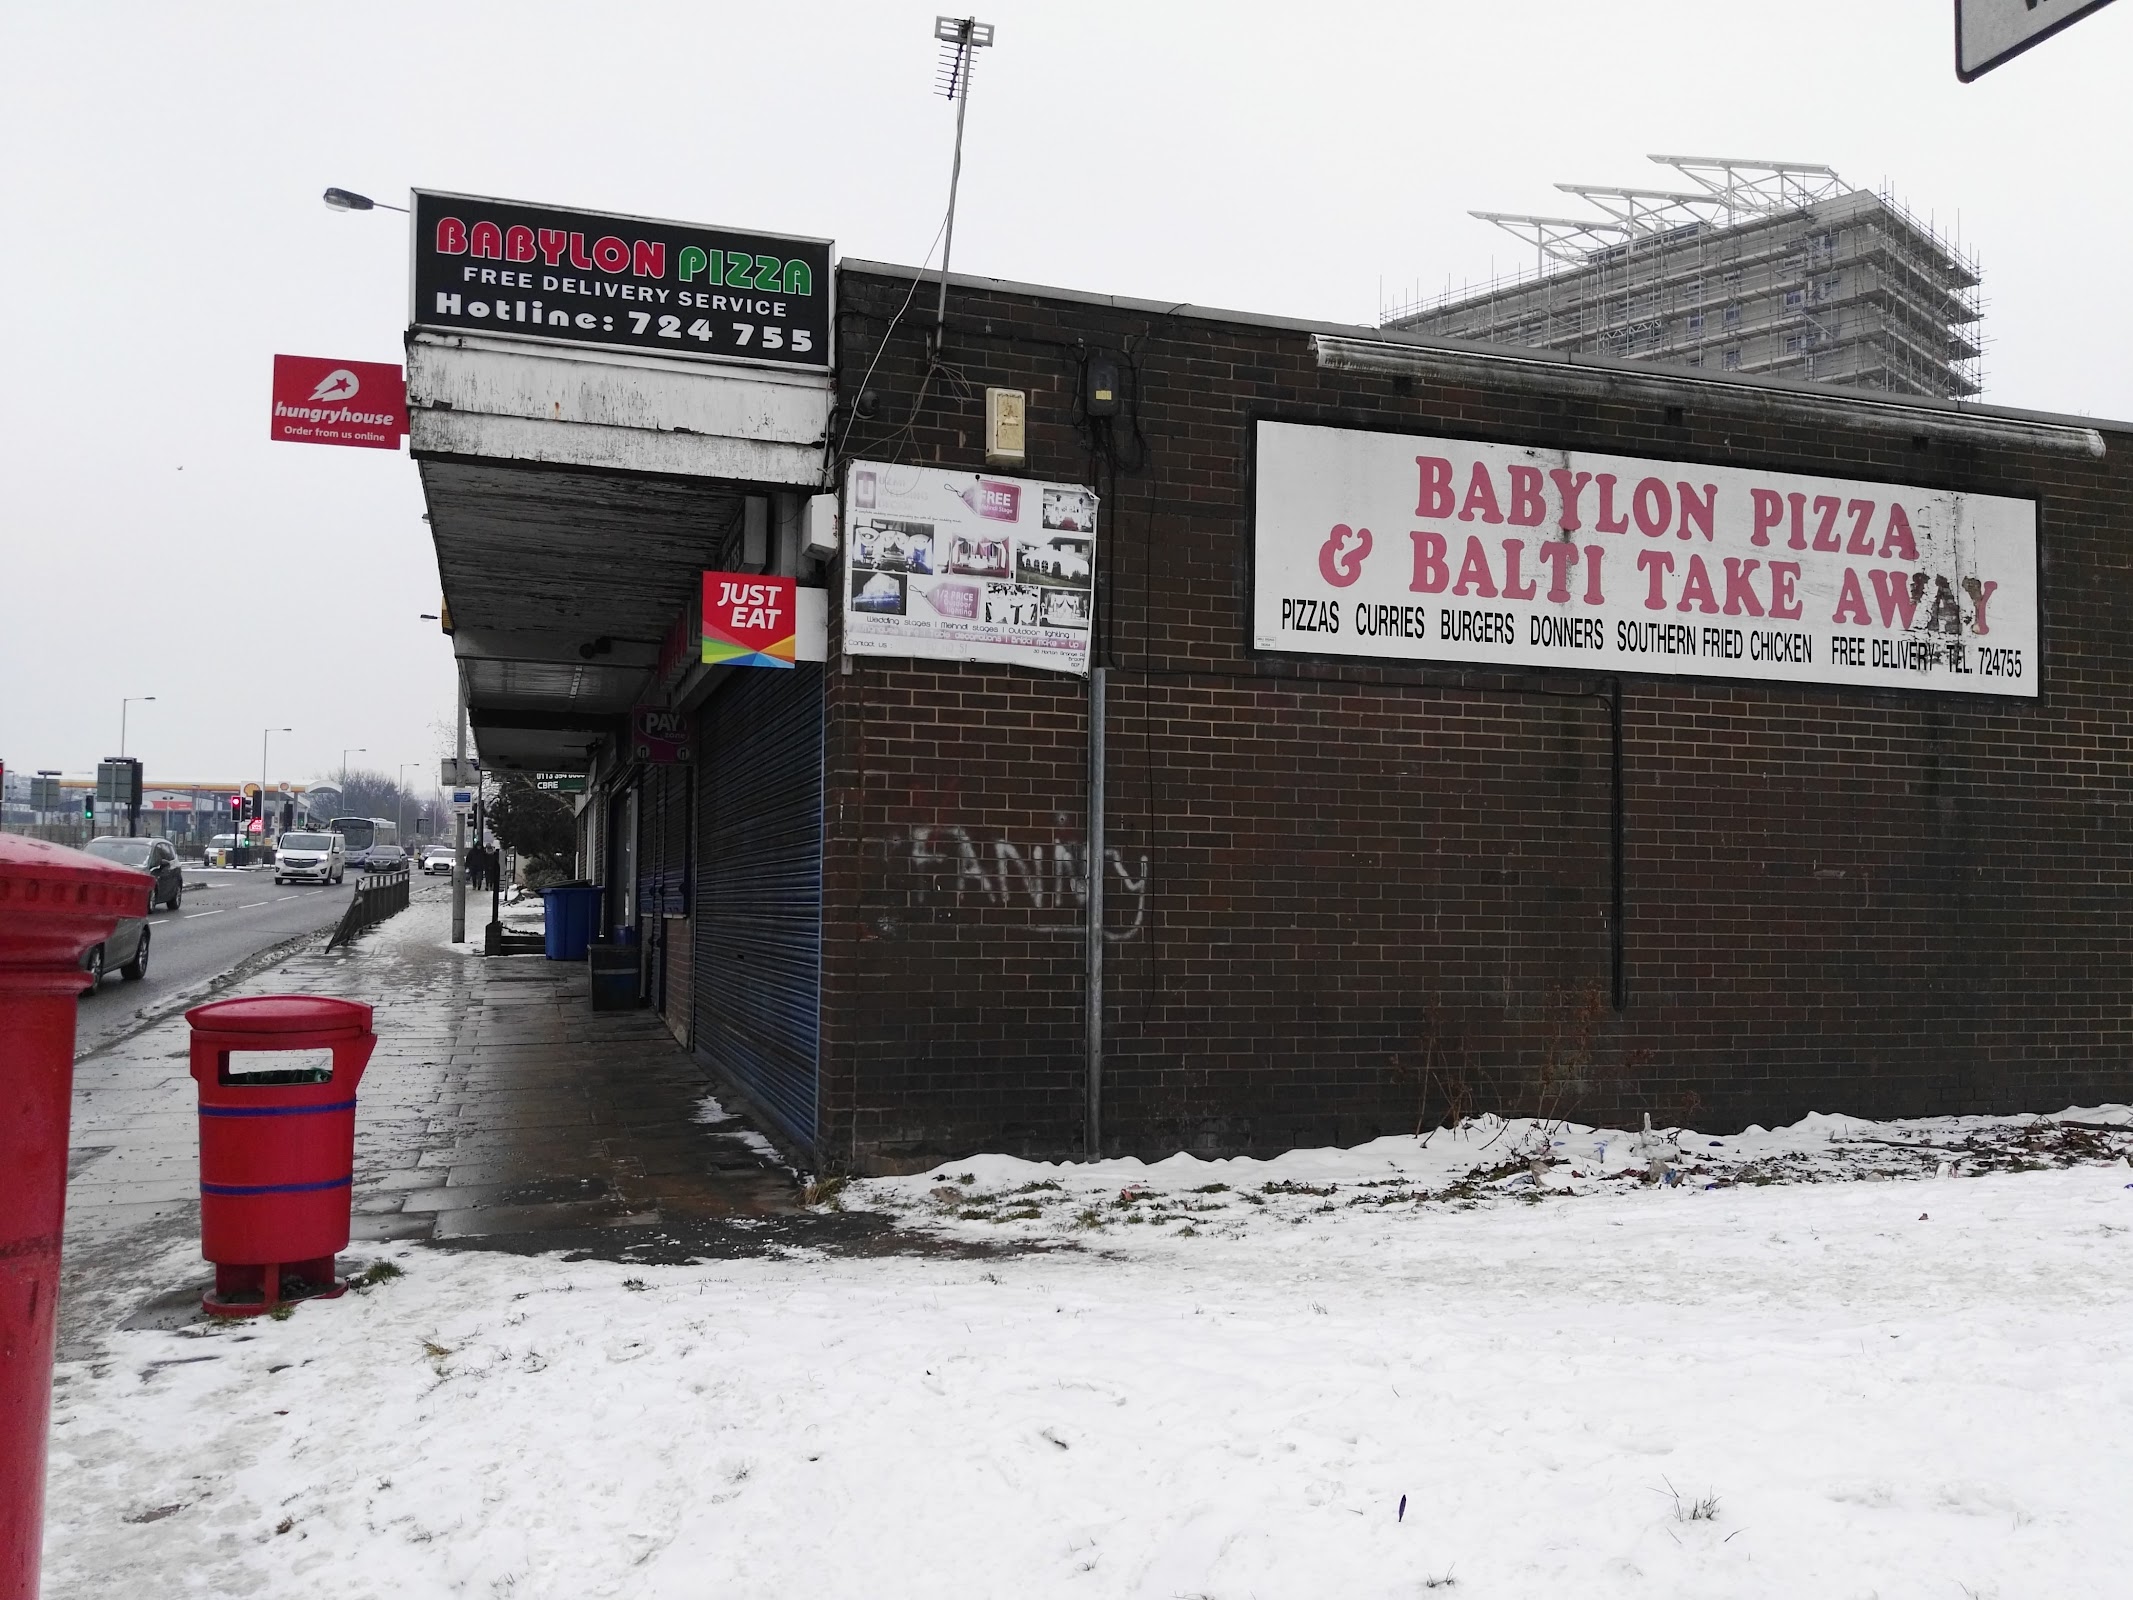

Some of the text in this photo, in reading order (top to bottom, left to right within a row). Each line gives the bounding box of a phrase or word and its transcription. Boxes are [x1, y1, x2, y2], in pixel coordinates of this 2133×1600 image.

[436, 217, 812, 296] BABYLON PIZZA
[463, 266, 787, 317] FREE DELIVERY SERVICE
[436, 292, 813, 352] Hotline: 724 755
[275, 401, 394, 425] hungryhouse
[284, 425, 385, 441] Order from us online
[980, 489, 1011, 507] FREE
[1414, 455, 1920, 561] BABYLON PIZZA
[1318, 523, 1998, 635] & BALTI TAKE AWAY
[717, 582, 782, 606] JUST
[943, 599, 972, 609] Outdoor
[950, 590, 974, 602] PRICE
[731, 606, 782, 629] EAT
[946, 606, 973, 617] lighting
[867, 615, 900, 625] Wedding
[904, 619, 931, 627] stages
[972, 625, 999, 633] stages
[1008, 627, 1041, 636] Outdoor
[1045, 630, 1070, 639] lighting
[1282, 598, 2023, 678] PIZZAS CURRIES BURGERS DONNERS SOUTHERN FRIED CHICKEN FREE DELIVERY TEL. 724755
[848, 639, 875, 648] Contact
[645, 712, 680, 734] PAY
[537, 781, 559, 789] CBRE
